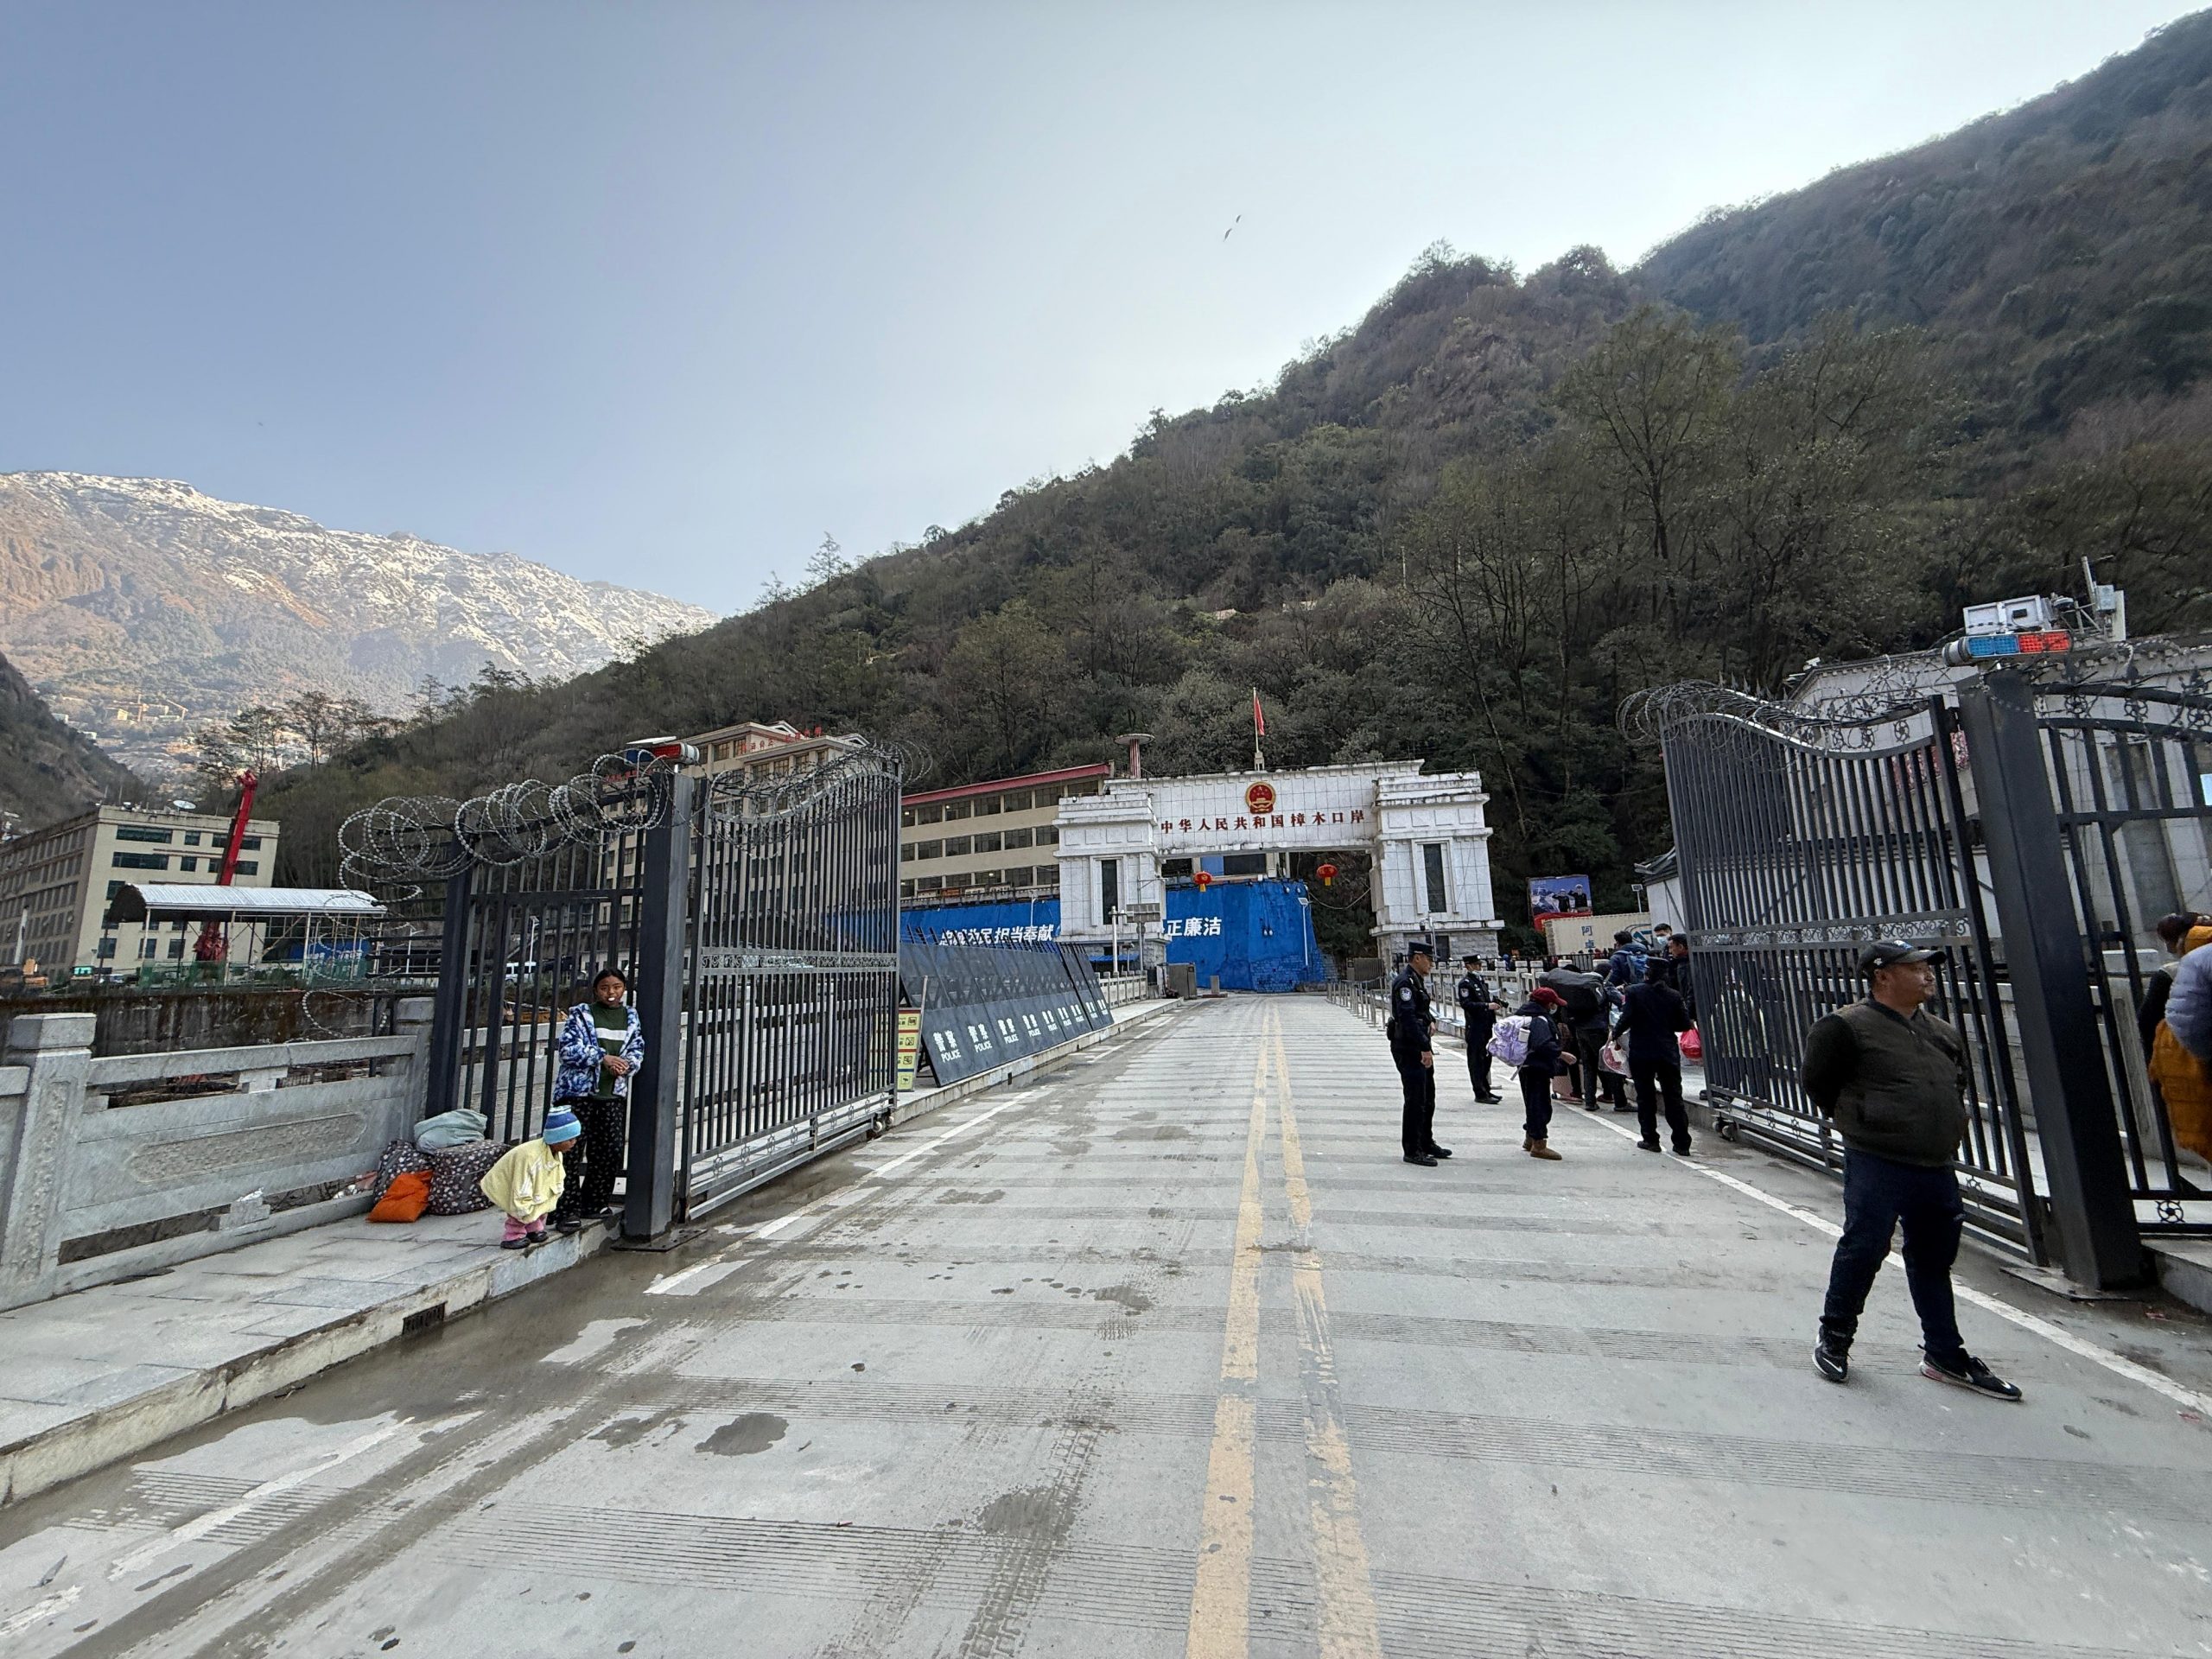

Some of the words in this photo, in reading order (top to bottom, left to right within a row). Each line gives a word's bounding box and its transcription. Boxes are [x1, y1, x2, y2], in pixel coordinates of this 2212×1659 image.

[1160, 810, 1365, 834] 中华人民共和国樟木口岸
[1162, 917, 1223, 937] 正廉洁
[933, 1030, 957, 1052] 警察
[968, 1023, 988, 1043] 警察
[1004, 1033, 1019, 1045] POLICE
[941, 1049, 962, 1063] POLICE
[974, 1040, 993, 1053] POLICE
